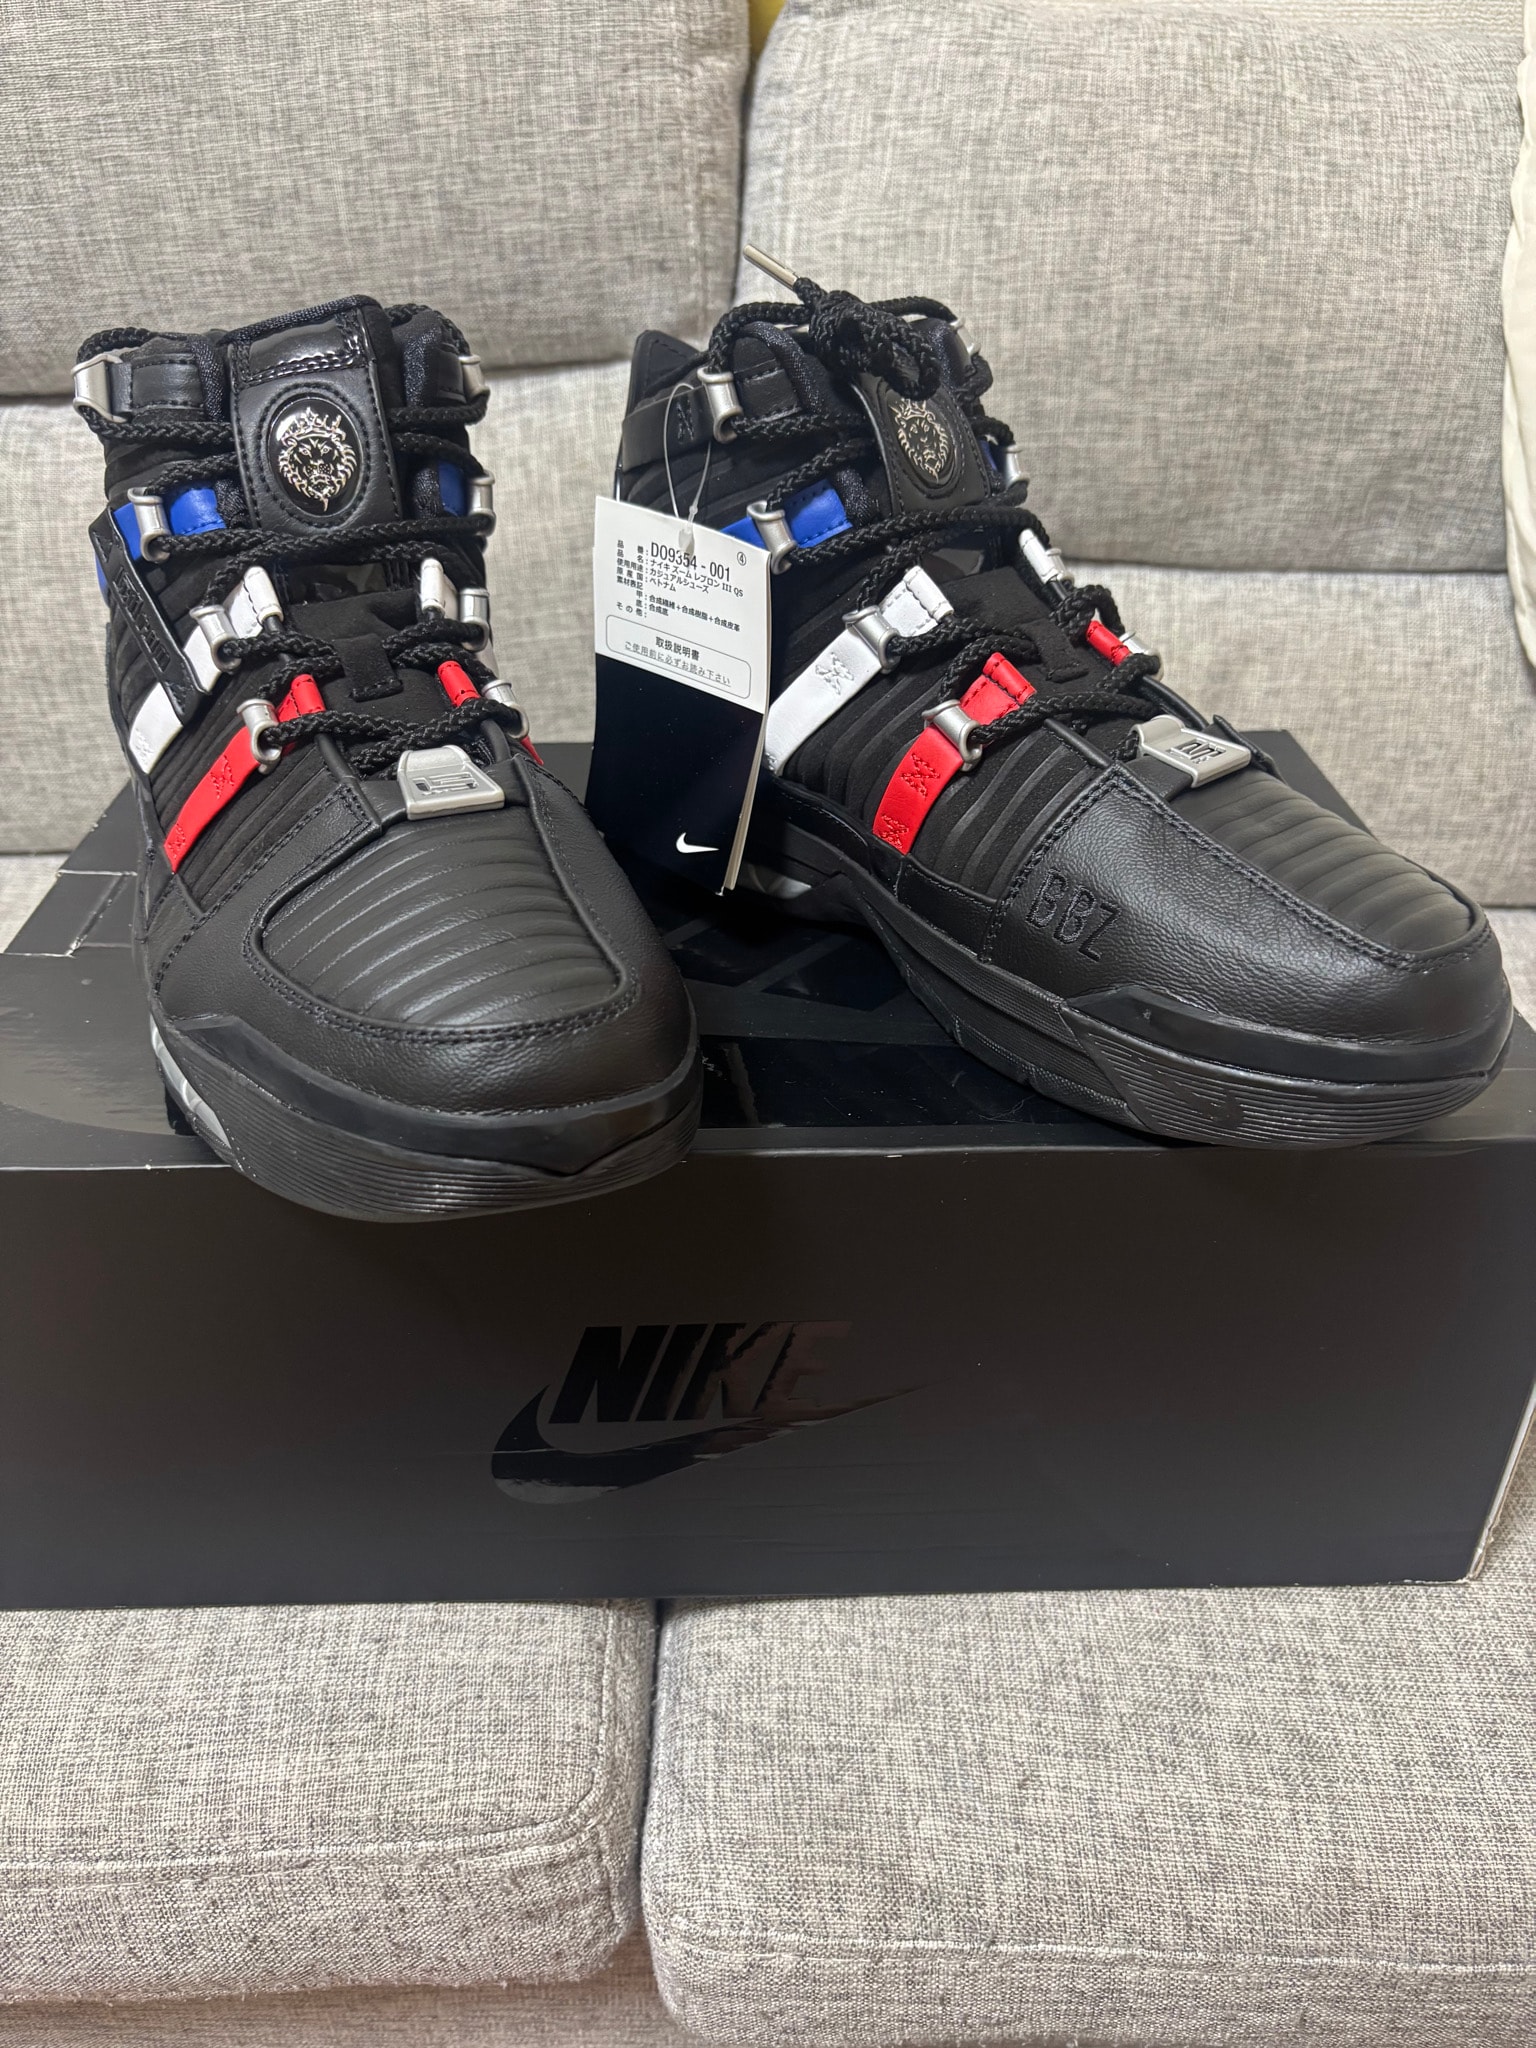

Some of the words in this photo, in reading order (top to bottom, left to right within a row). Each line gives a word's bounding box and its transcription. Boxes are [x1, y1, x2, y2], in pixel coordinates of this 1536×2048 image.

[649, 568, 709, 594] カジュアルシューズ
[649, 577, 676, 592] ベトナム
[650, 559, 670, 571] ナイキ
[672, 565, 692, 579] ズーム
[695, 573, 720, 588] レブロン
[734, 587, 744, 598] QS
[709, 561, 730, 582] 001
[625, 641, 731, 685] ご使用前に必ずお読み下さい
[655, 636, 700, 661] 取扱説明書
[1025, 866, 1121, 962] BBZ
[549, 1320, 853, 1424] NIKE
